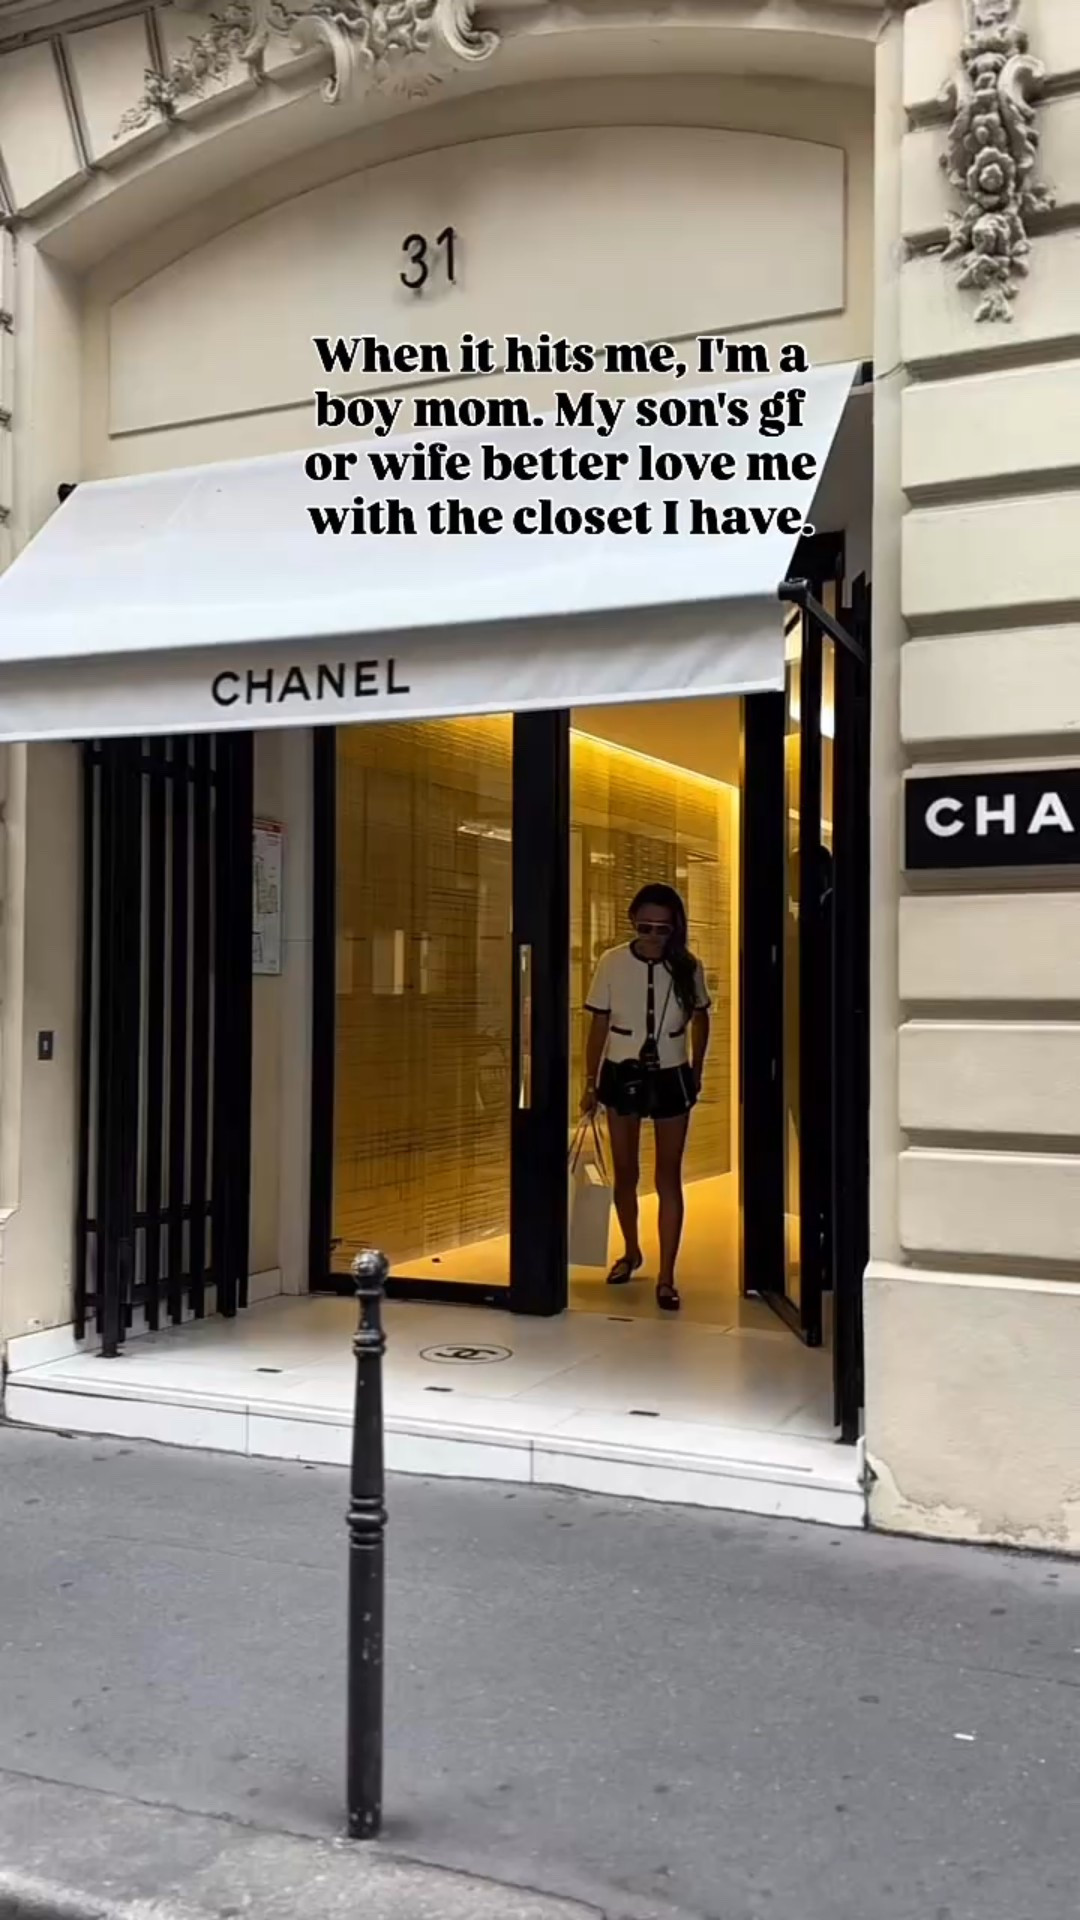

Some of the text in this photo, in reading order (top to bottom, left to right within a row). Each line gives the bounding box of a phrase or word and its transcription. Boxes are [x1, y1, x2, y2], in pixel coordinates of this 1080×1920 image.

[400, 227, 455, 289] 31
[211, 657, 411, 707] CHANEL
[924, 791, 1076, 838] CHA
